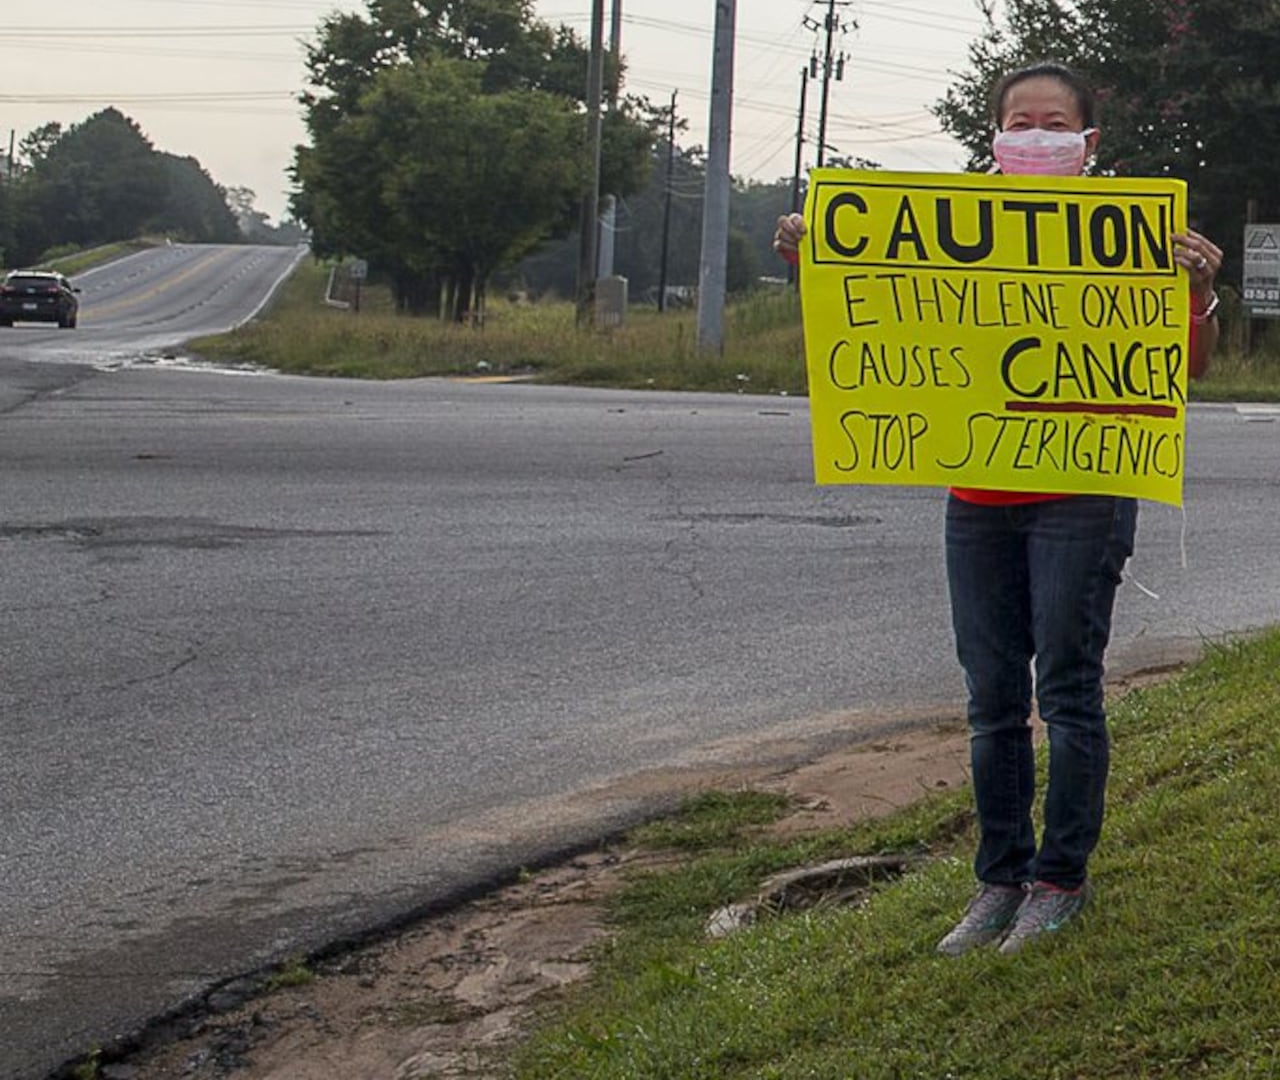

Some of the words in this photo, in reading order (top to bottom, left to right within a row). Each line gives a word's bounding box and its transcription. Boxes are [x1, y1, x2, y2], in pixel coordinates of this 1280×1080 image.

[823, 192, 1173, 270] CAUTION
[842, 272, 1069, 330] ETHYLENE
[1080, 282, 1181, 330] OXIDE
[828, 339, 972, 390] CAUSES
[1000, 335, 1186, 403] CANCER
[834, 410, 929, 472] STOP
[936, 413, 1183, 478] STERIGENICS
